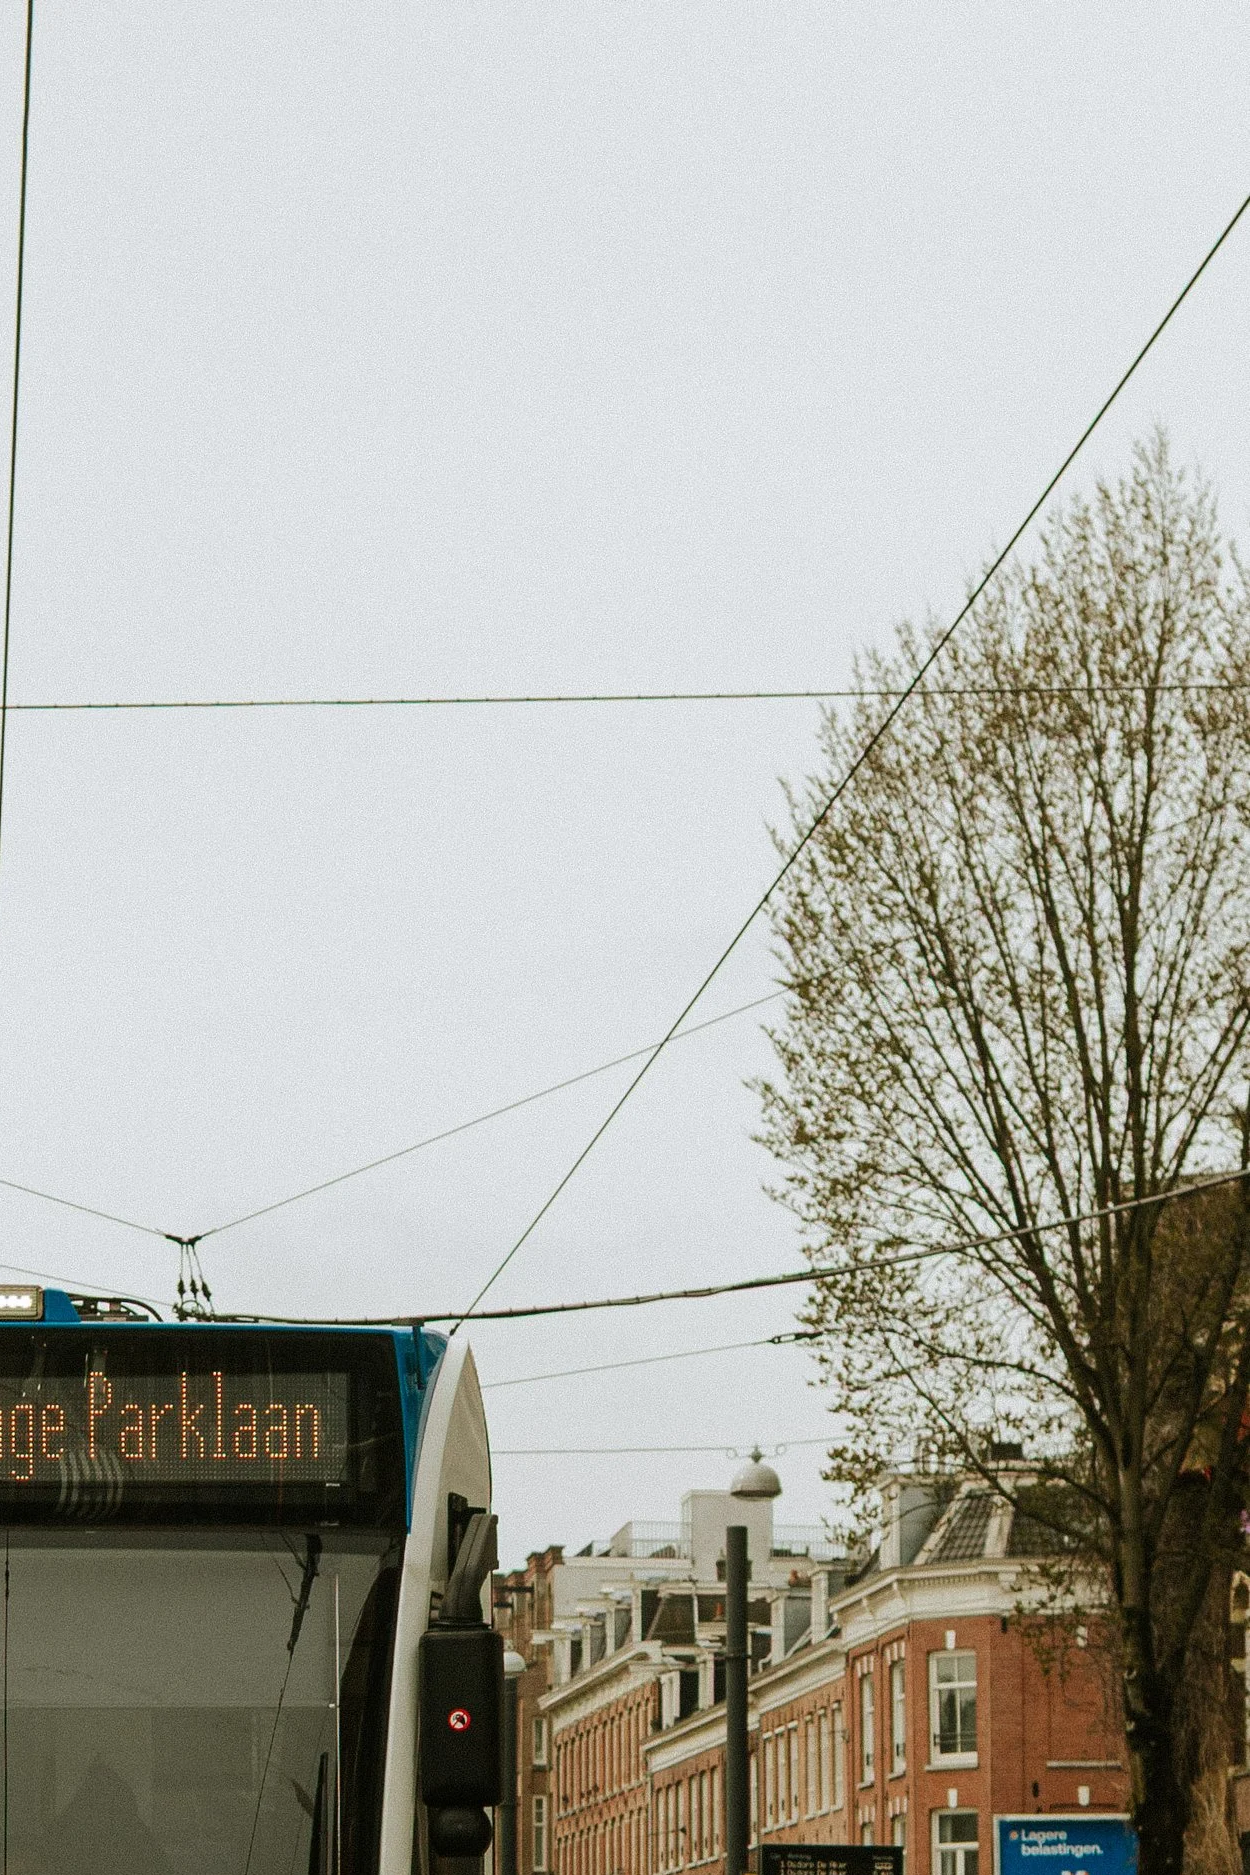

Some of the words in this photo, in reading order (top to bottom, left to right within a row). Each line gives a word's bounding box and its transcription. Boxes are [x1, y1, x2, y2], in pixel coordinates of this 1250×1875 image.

[88, 1371, 319, 1459] Parklaan
[1021, 1828, 1067, 1844] Lagere
[1021, 1843, 1104, 1858] belastingen.
